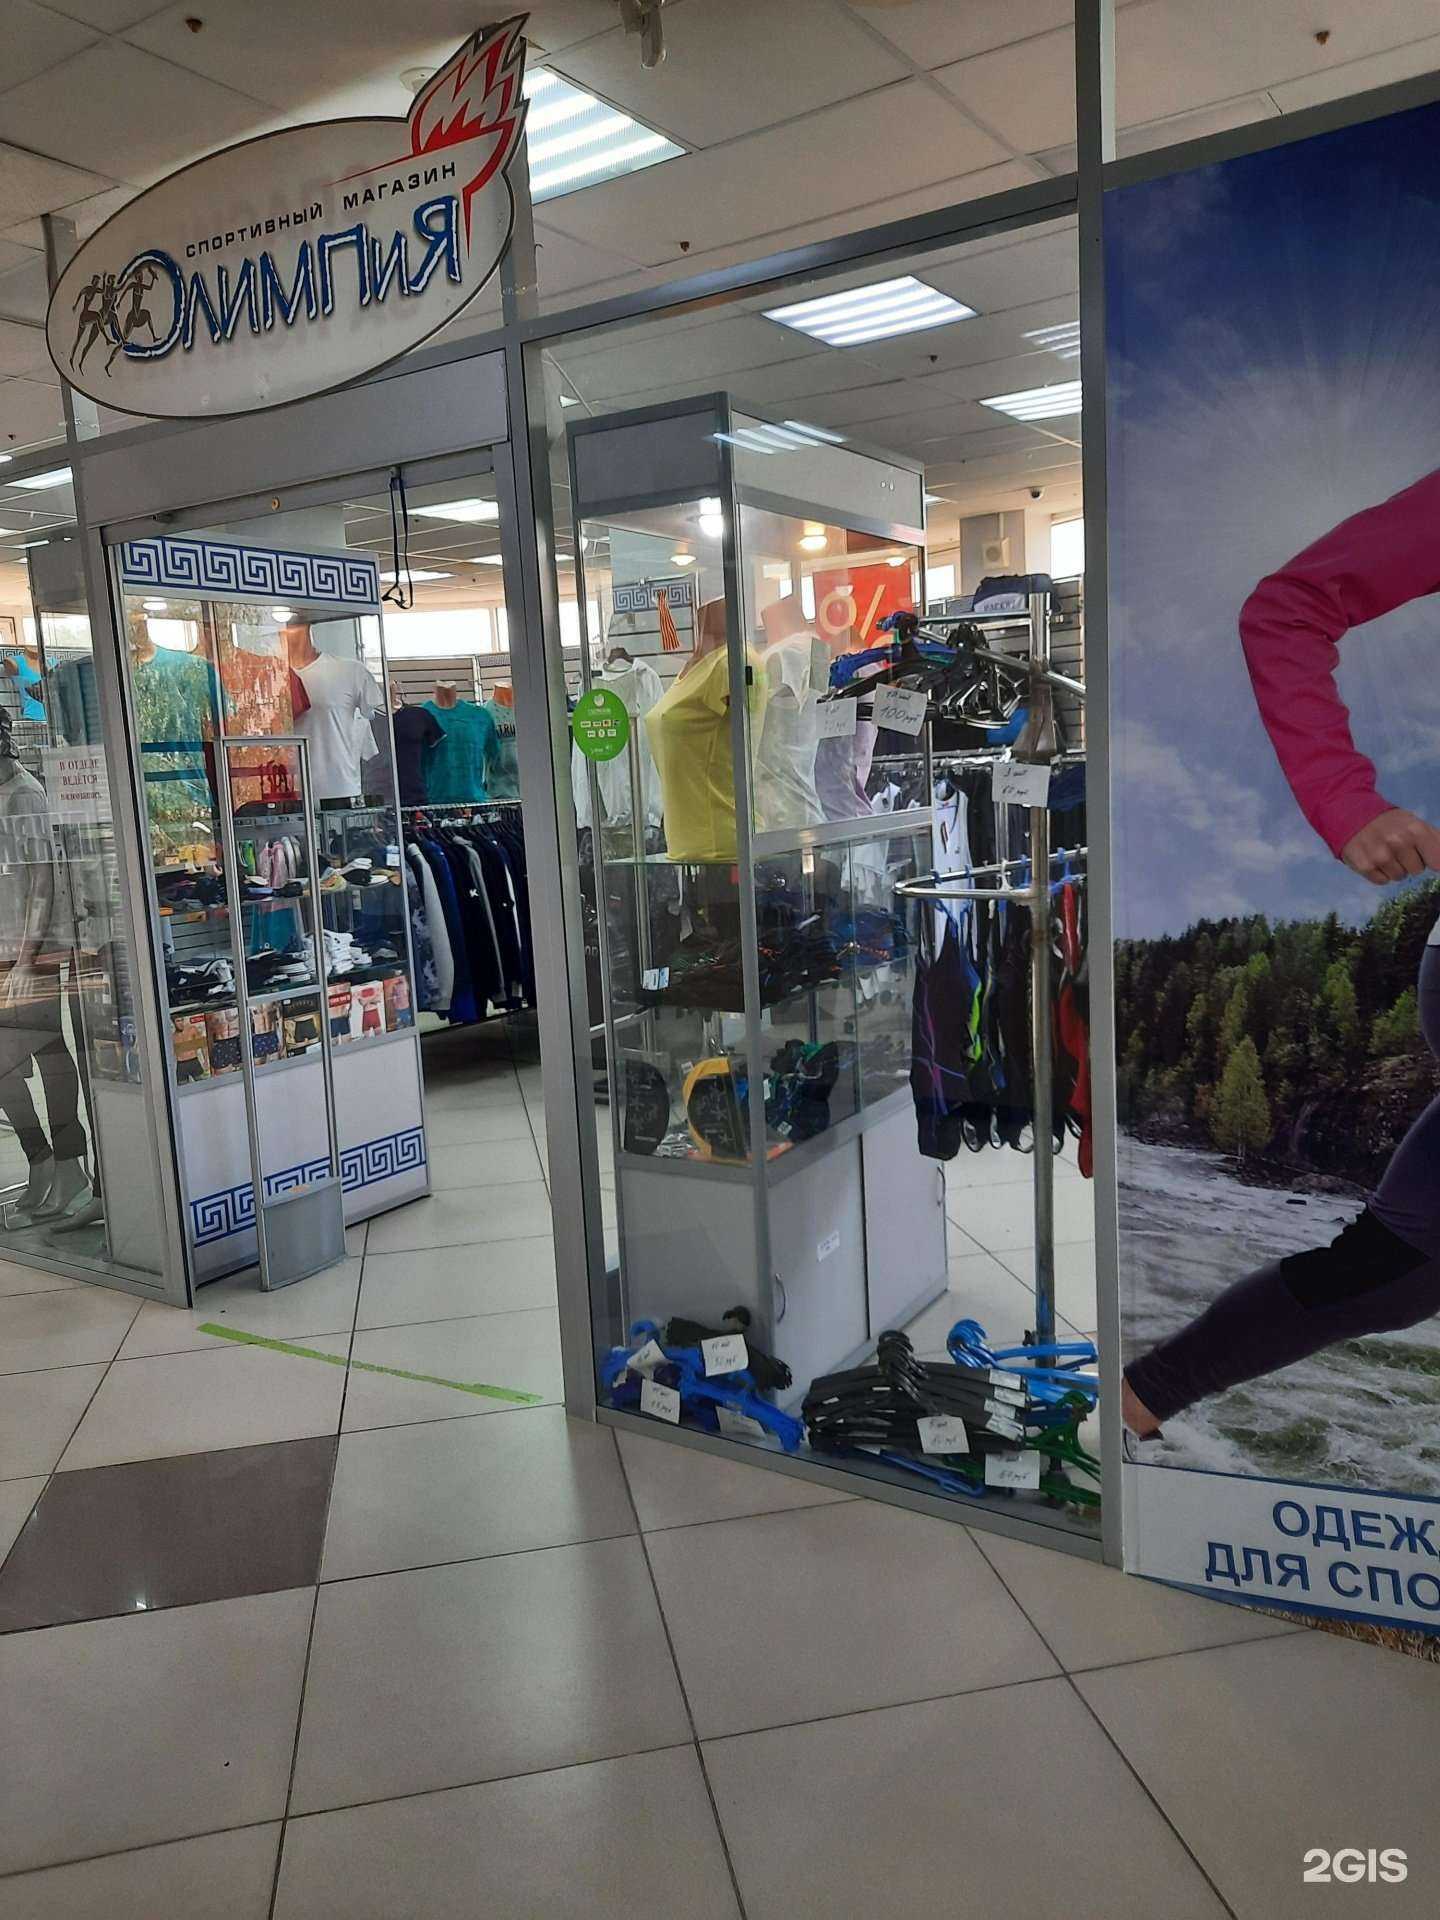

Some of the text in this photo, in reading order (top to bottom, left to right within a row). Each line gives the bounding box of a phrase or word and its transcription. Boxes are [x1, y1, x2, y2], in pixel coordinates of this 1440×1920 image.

[186, 162, 456, 258] СПОРТИВНЫЙ МАГАЗИН
[1272, 1500, 1440, 1558] ОДЕЖ
[1205, 1541, 1440, 1611] ДЛЯ СПО
